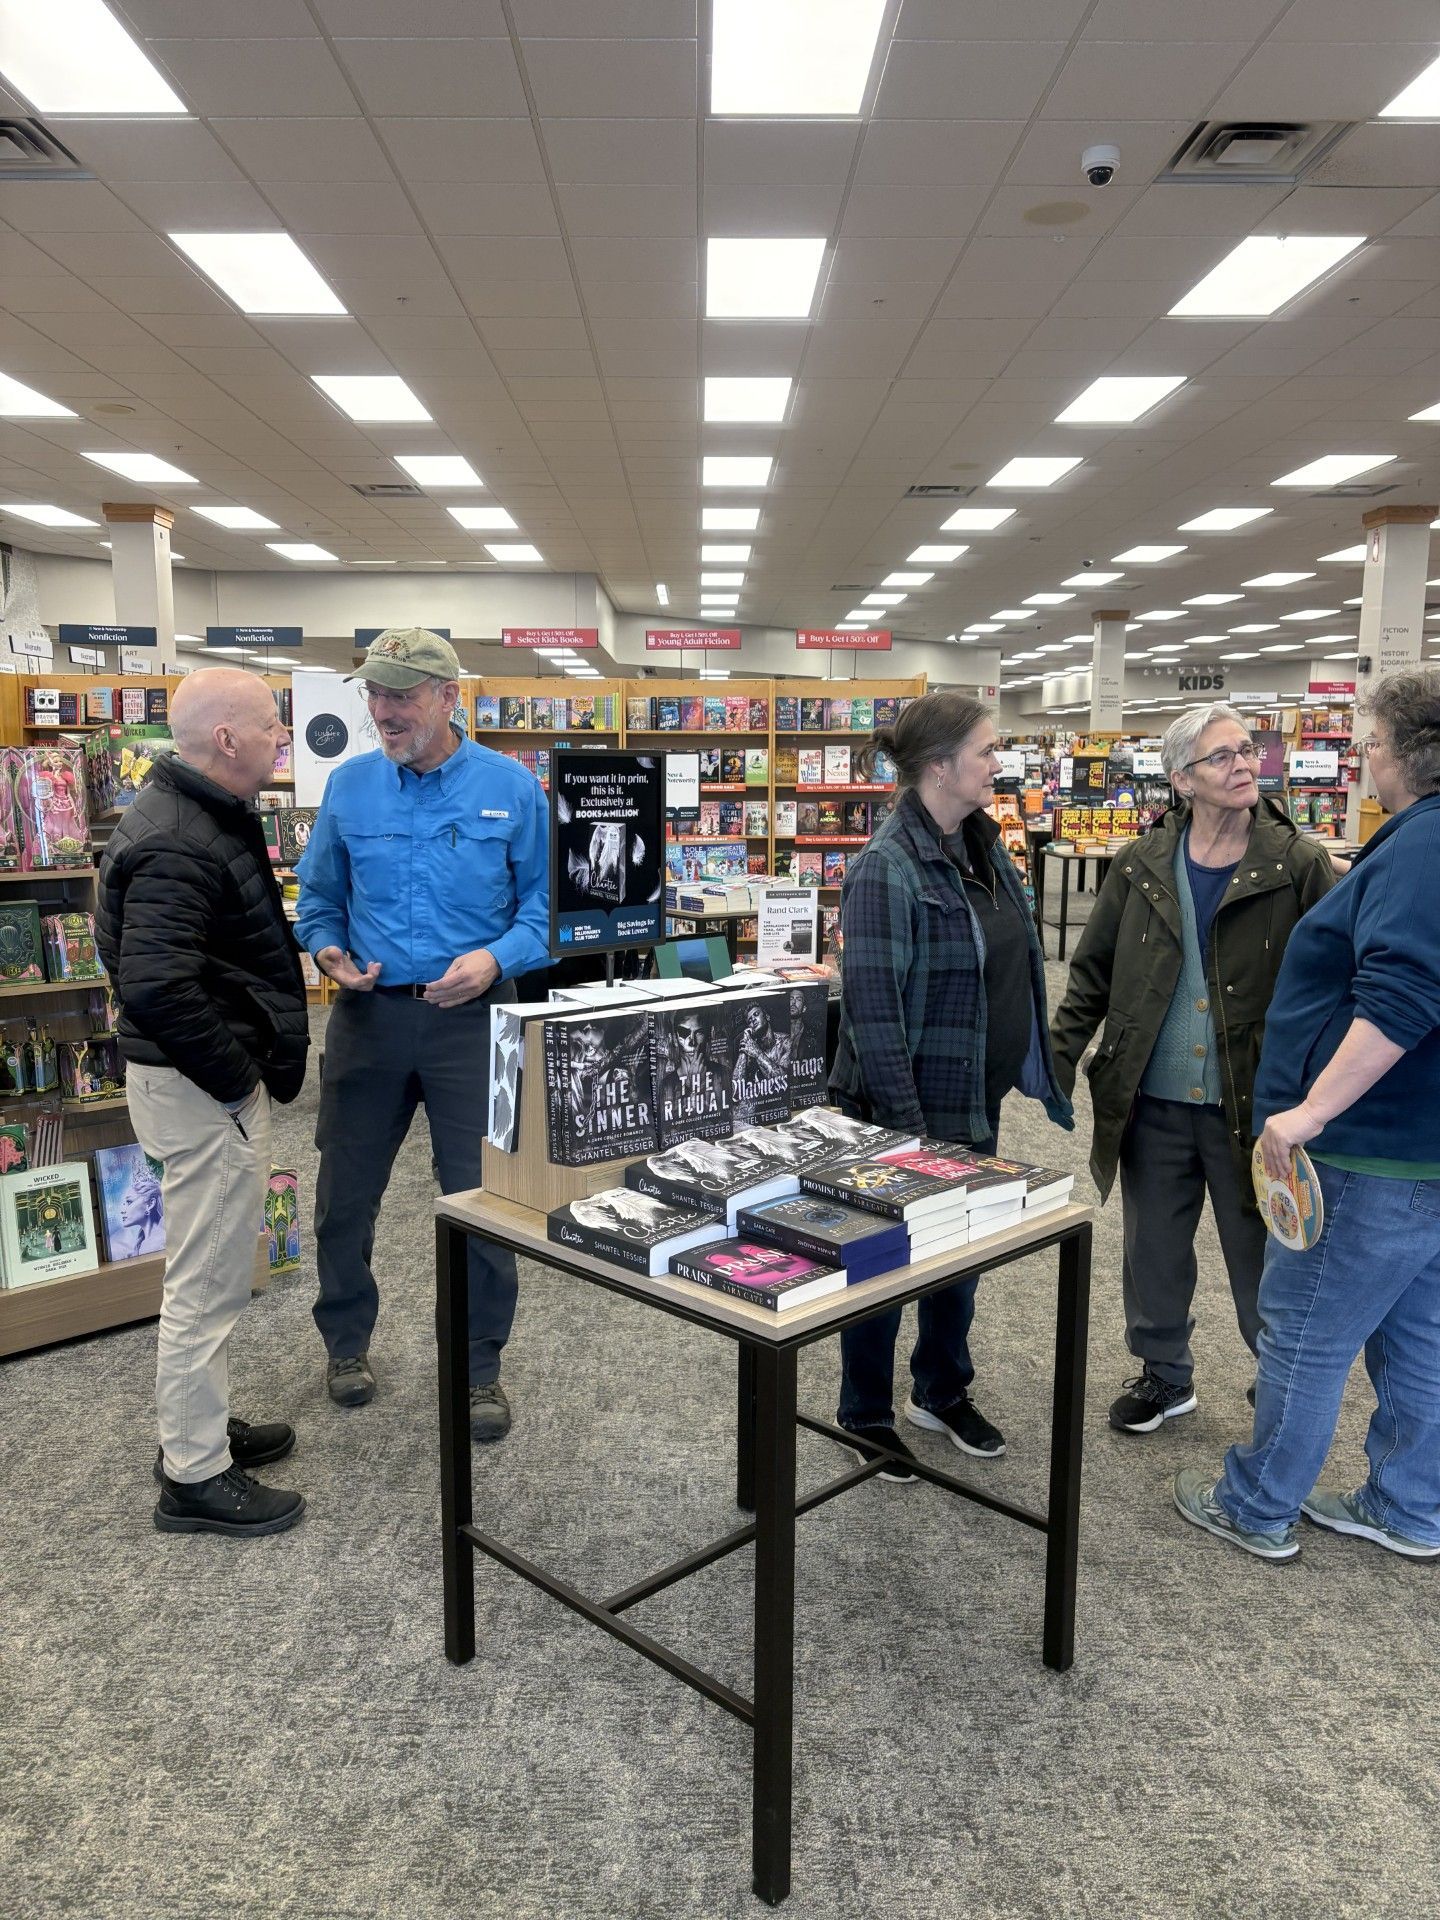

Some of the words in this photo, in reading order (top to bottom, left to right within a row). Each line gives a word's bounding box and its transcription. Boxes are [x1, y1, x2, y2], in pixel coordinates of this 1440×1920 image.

[88, 632, 128, 642] Nonfiction
[236, 634, 274, 642] Nonfiction
[810, 635, 824, 644] Buy
[1179, 674, 1224, 691] KIDS
[565, 774, 571, 783] If
[573, 776, 588, 785] you
[589, 774, 609, 783] want
[611, 774, 616, 783] it
[619, 774, 626, 783] in
[628, 773, 648, 785] print,
[591, 786, 606, 795] this
[608, 786, 615, 794] is
[581, 797, 624, 807] Exclusively
[618, 921, 627, 929] Big
[627, 919, 646, 928] Savings
[632, 927, 648, 935] Lovers
[546, 1026, 554, 1045] THE
[649, 1039, 657, 1077] RITUAL
[791, 1056, 824, 1079] nage
[547, 1052, 556, 1088] SINNER
[561, 1052, 569, 1089] SINNER
[680, 1071, 713, 1095] THE
[732, 1074, 788, 1102] Madness
[595, 1080, 630, 1108] THE
[800, 1095, 827, 1106] TESSIER
[664, 1090, 729, 1121] RITUAL
[575, 1103, 650, 1137] SINNER
[761, 1110, 789, 1121] TESSIER
[664, 1133, 695, 1146] SHANTEL
[701, 1126, 730, 1137] TESSIER
[575, 1148, 615, 1163] SHANTEL
[618, 1141, 654, 1154] TESSIER
[34, 1174, 60, 1182] WICKED
[639, 1178, 661, 1195] Chaotic
[701, 1164, 770, 1191] Chaotic
[803, 1180, 836, 1197] PROMISE
[838, 1190, 849, 1201] ME
[896, 1187, 926, 1204] SARA
[672, 1192, 698, 1207] SHANTEL
[700, 1201, 724, 1214] TESSIER
[871, 1202, 888, 1213] CATE
[561, 1226, 584, 1244] Chaotic
[623, 1212, 697, 1239] Chaotic
[754, 1223, 764, 1231] SARA
[765, 1226, 776, 1234] CATE
[594, 1241, 620, 1257] SHANTEL
[622, 1250, 647, 1265] TESSIER
[677, 1263, 713, 1287] PRAISE
[722, 1283, 741, 1296] SARA
[743, 1291, 764, 1305] CATE
[770, 1278, 802, 1292] SARA
